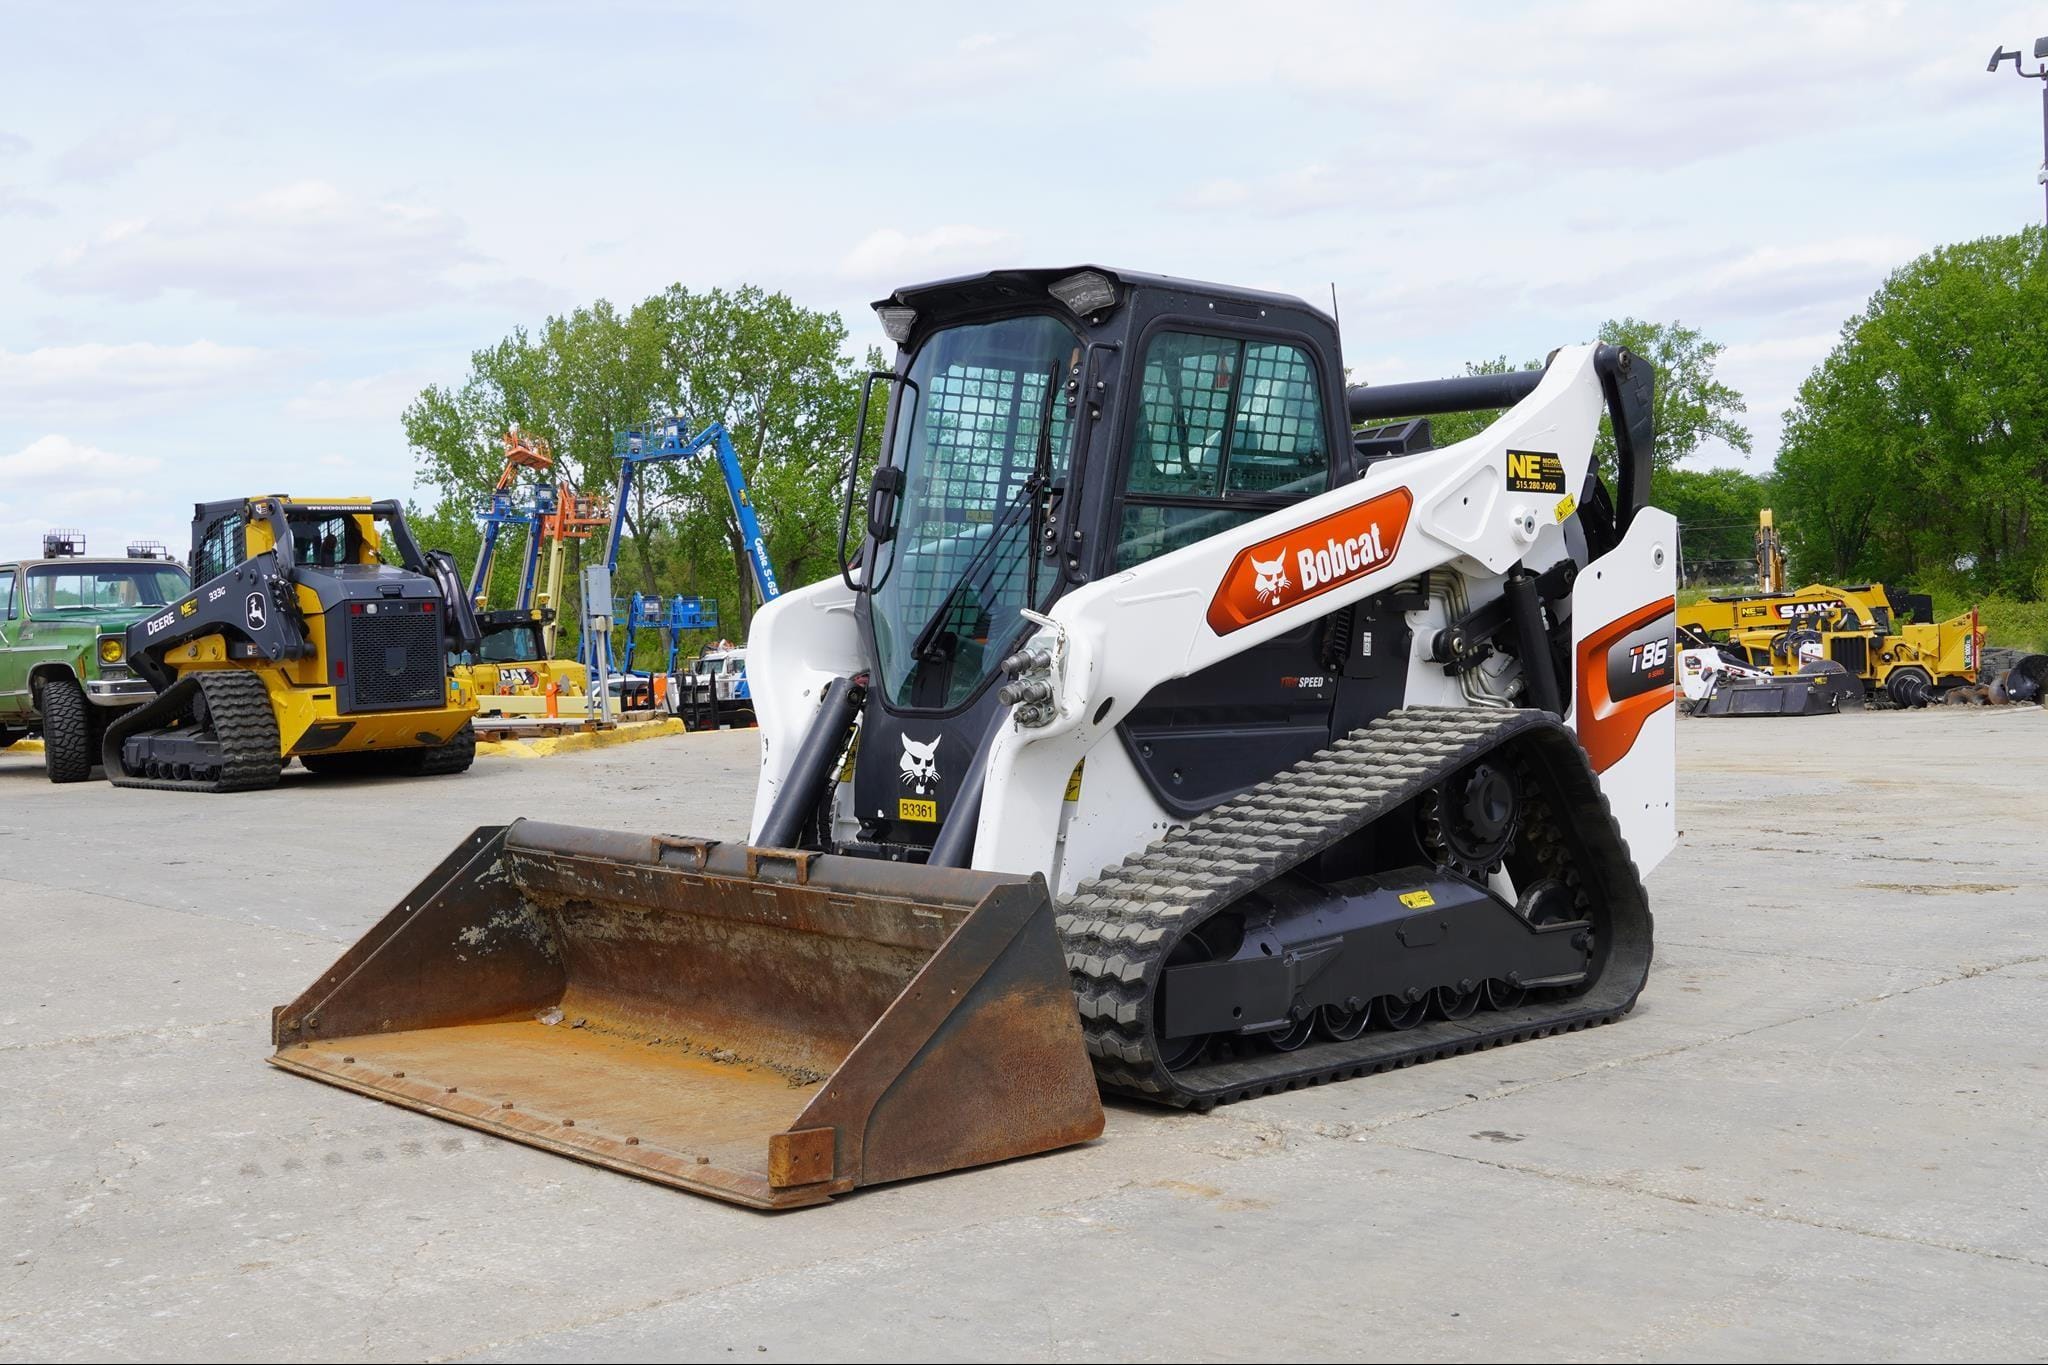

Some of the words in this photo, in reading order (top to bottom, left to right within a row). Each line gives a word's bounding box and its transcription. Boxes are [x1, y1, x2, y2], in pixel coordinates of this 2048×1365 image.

[1508, 454, 1541, 479] NE
[1515, 480, 1557, 491] 515.280.7600
[754, 537, 768, 567] Genie
[764, 568, 779, 596] S-65
[1297, 522, 1384, 591] Bobcat
[208, 586, 226, 602] 333G
[147, 611, 175, 636] DEERE
[1629, 638, 1668, 674] T86
[500, 668, 529, 684] CAT
[1298, 676, 1324, 688] SPEED
[902, 803, 932, 818] B3361
